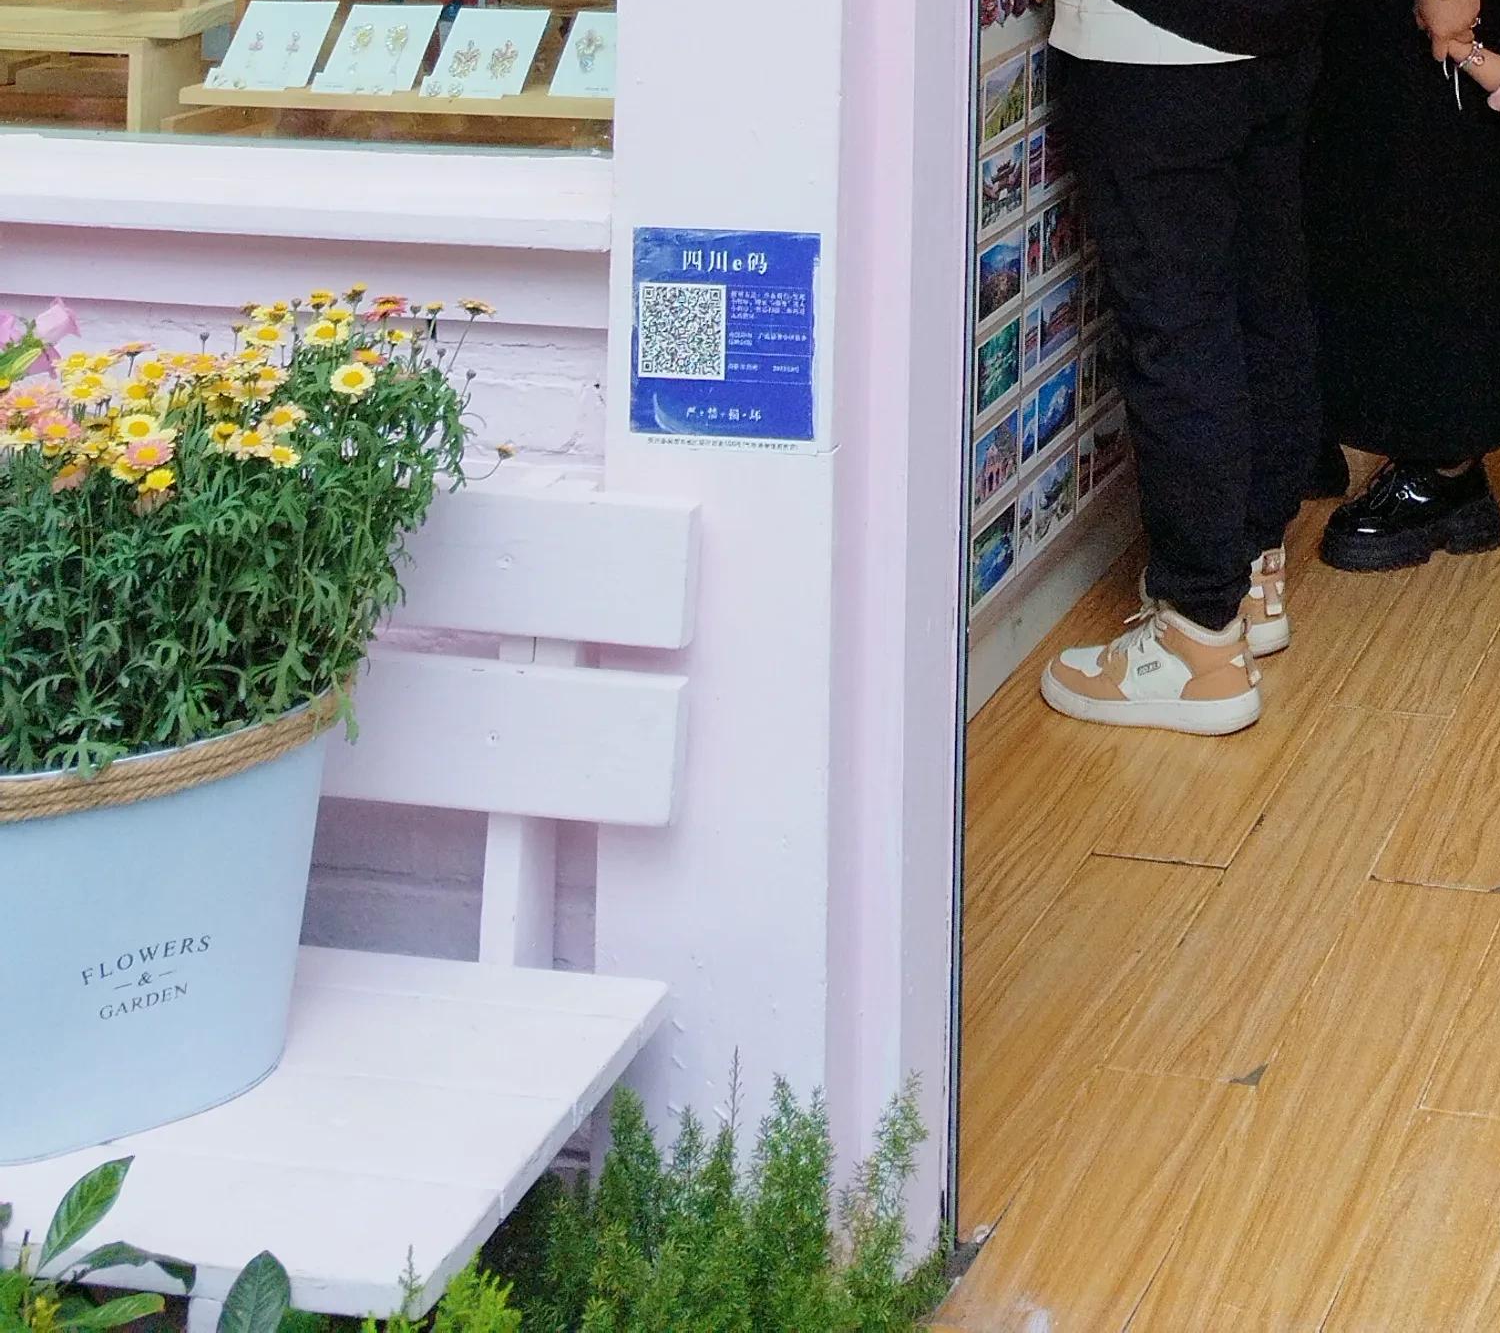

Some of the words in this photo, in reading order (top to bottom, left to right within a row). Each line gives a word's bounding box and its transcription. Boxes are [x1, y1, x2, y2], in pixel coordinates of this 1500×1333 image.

[81, 935, 212, 985] FLOWERS
[137, 971, 152, 986] &
[99, 983, 189, 1020] GARDEN
